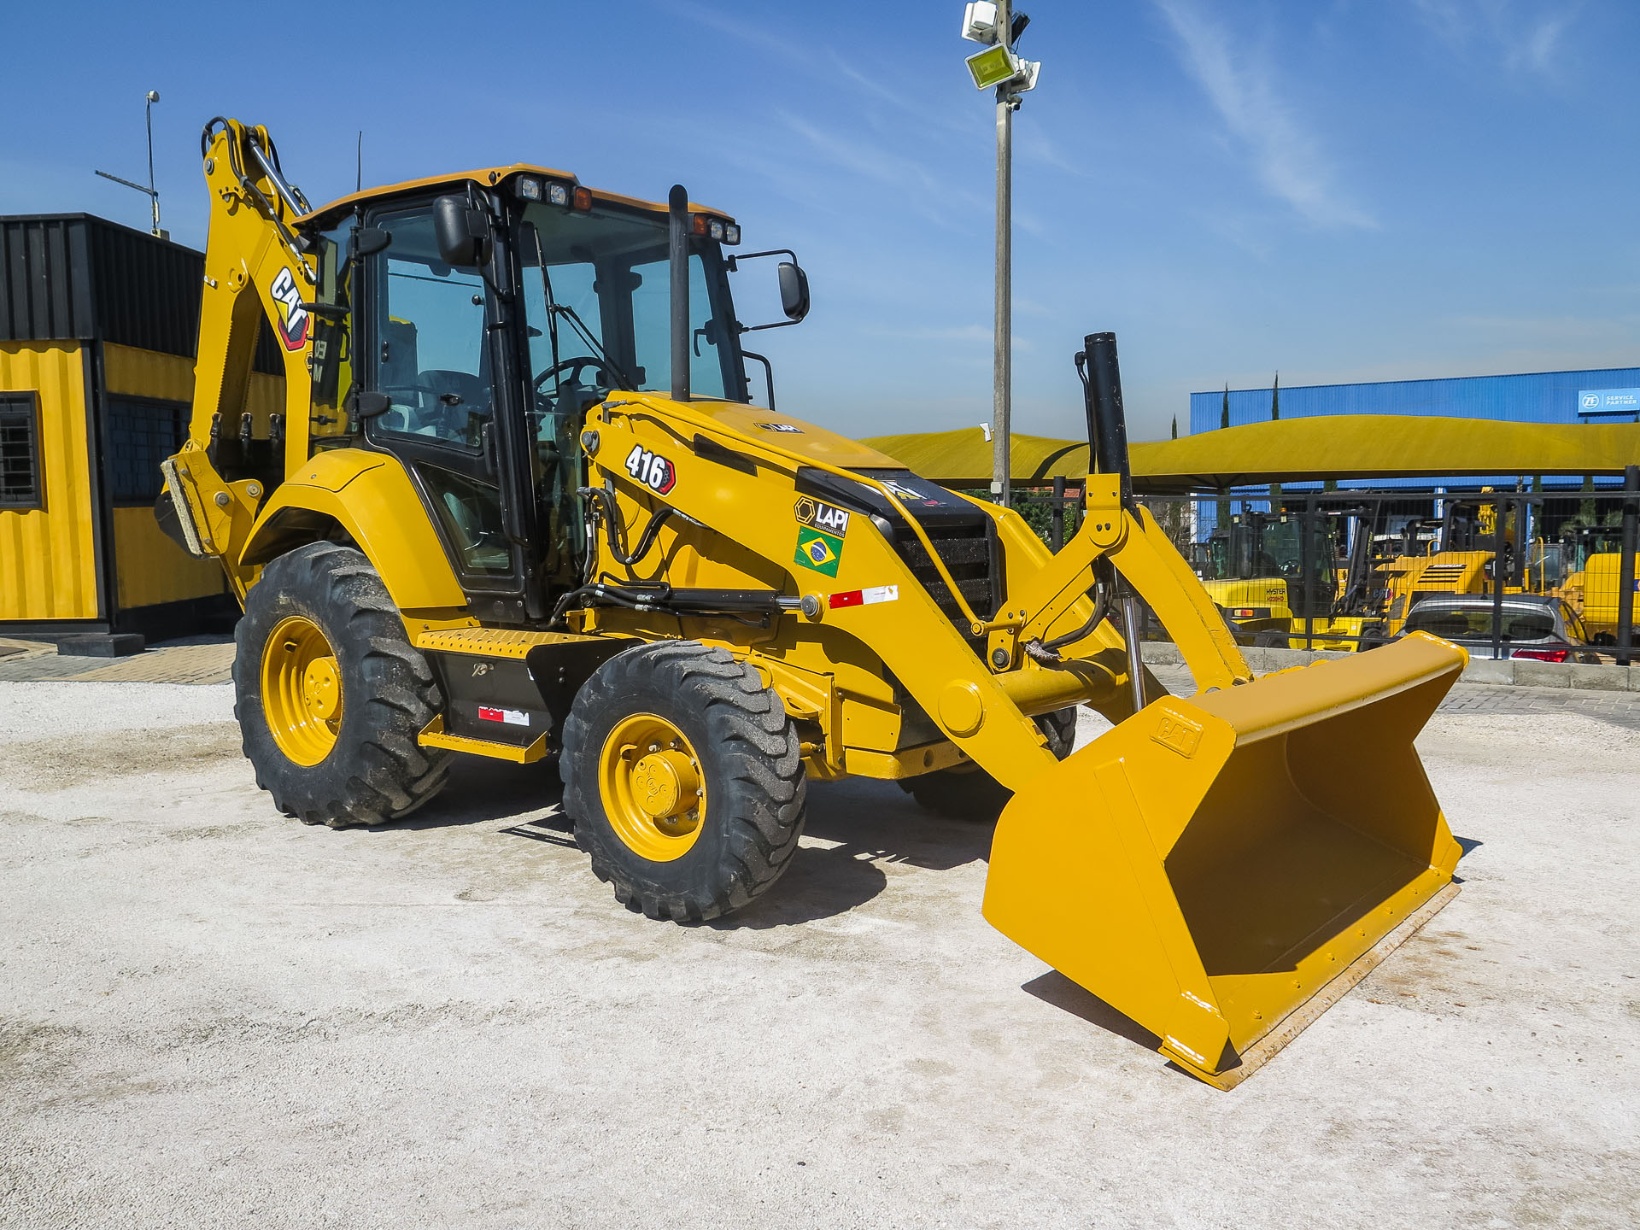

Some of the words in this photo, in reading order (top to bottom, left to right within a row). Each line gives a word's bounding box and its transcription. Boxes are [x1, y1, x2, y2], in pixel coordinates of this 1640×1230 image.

[271, 267, 308, 333] CAT
[626, 445, 665, 488] 416
[815, 503, 848, 532] LAPI
[1157, 717, 1195, 749] CAT
